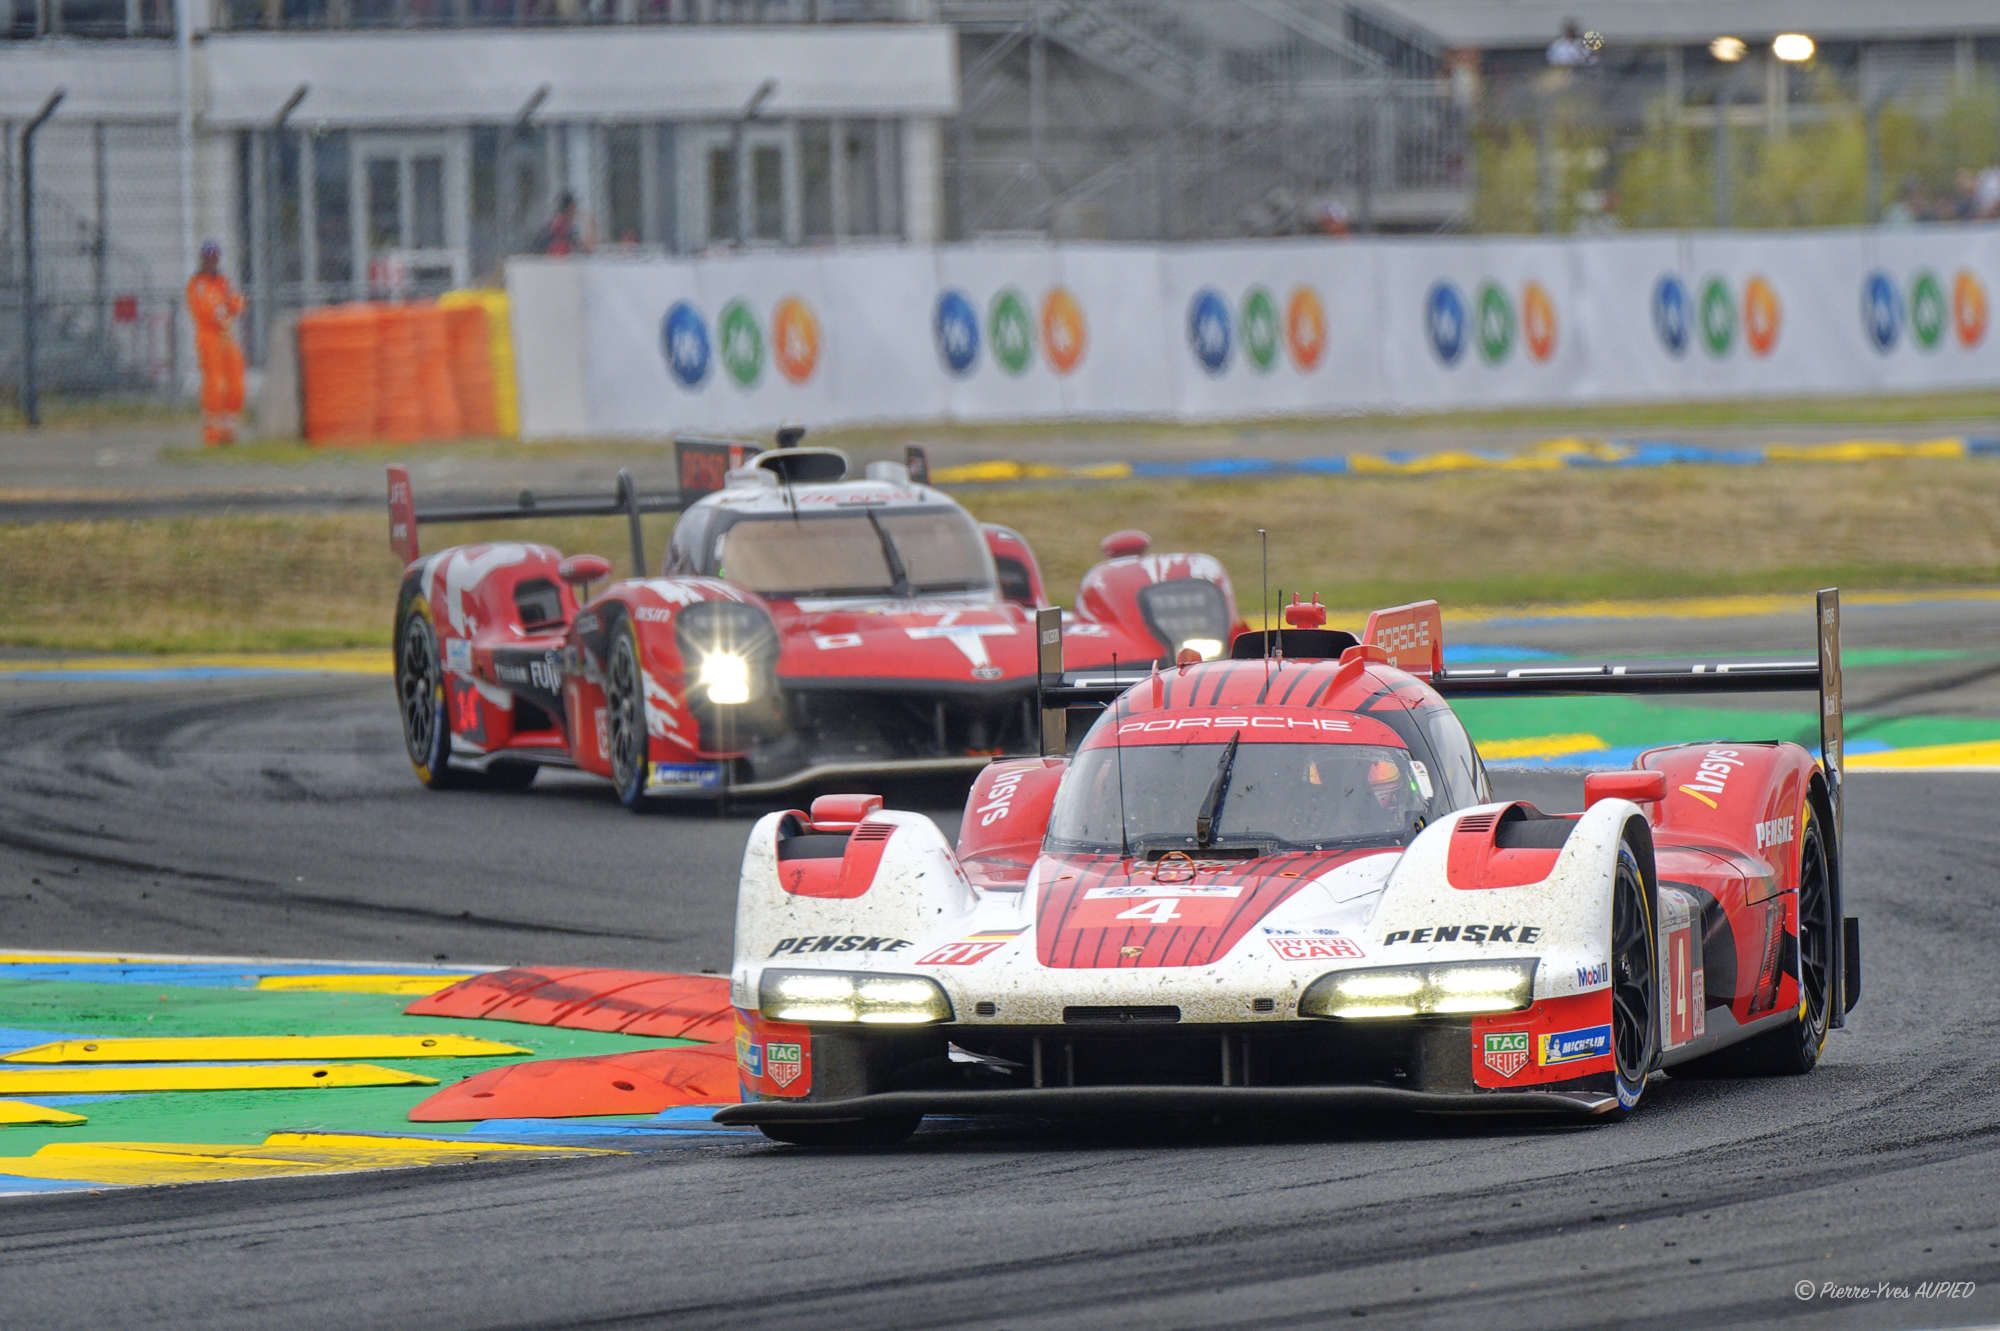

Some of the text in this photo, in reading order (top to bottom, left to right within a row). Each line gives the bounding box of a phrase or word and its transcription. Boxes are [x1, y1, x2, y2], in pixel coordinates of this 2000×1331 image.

[1376, 620, 1430, 653] PORSCHE
[1118, 716, 1352, 735] PORSCHE
[1678, 749, 1745, 809] Ansys
[976, 766, 1041, 827] Ansys
[1755, 815, 1794, 849] PENSKE
[1115, 898, 1182, 923] 4
[768, 935, 914, 958] PENSKE
[1274, 939, 1349, 947] HYPER
[1383, 924, 1541, 946] PENSKE
[1282, 946, 1357, 958] CAR
[1576, 963, 1602, 987] Mobil
[769, 1047, 798, 1060] TAG
[1489, 1037, 1525, 1050] TAG
[769, 1062, 799, 1085] HEUER
[1487, 1053, 1526, 1074] HEUER
